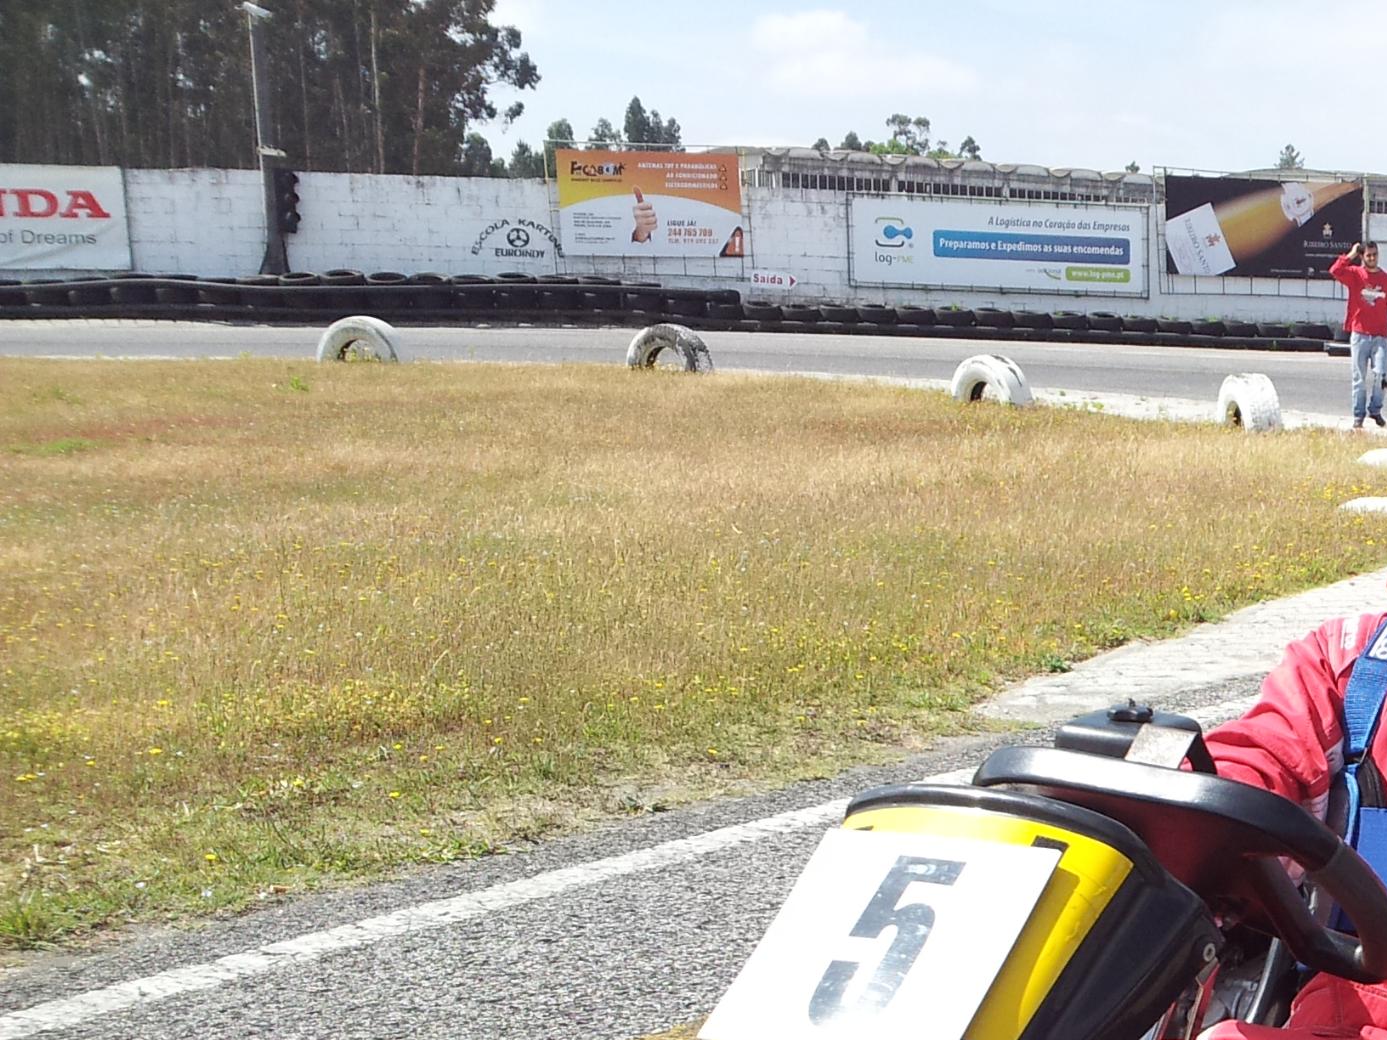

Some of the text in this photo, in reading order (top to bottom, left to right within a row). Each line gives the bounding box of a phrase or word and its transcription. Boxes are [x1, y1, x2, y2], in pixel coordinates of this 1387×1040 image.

[21, 229, 97, 244] Dreams
[471, 218, 510, 256] ESCOLA
[494, 247, 545, 258] EUROINDY
[939, 238, 990, 250] Preparamos
[998, 240, 1042, 252] Expedimos
[1043, 244, 1053, 252] as
[1054, 244, 1072, 253] suas
[1073, 246, 1124, 256] encomendas
[808, 854, 967, 1027] 5
